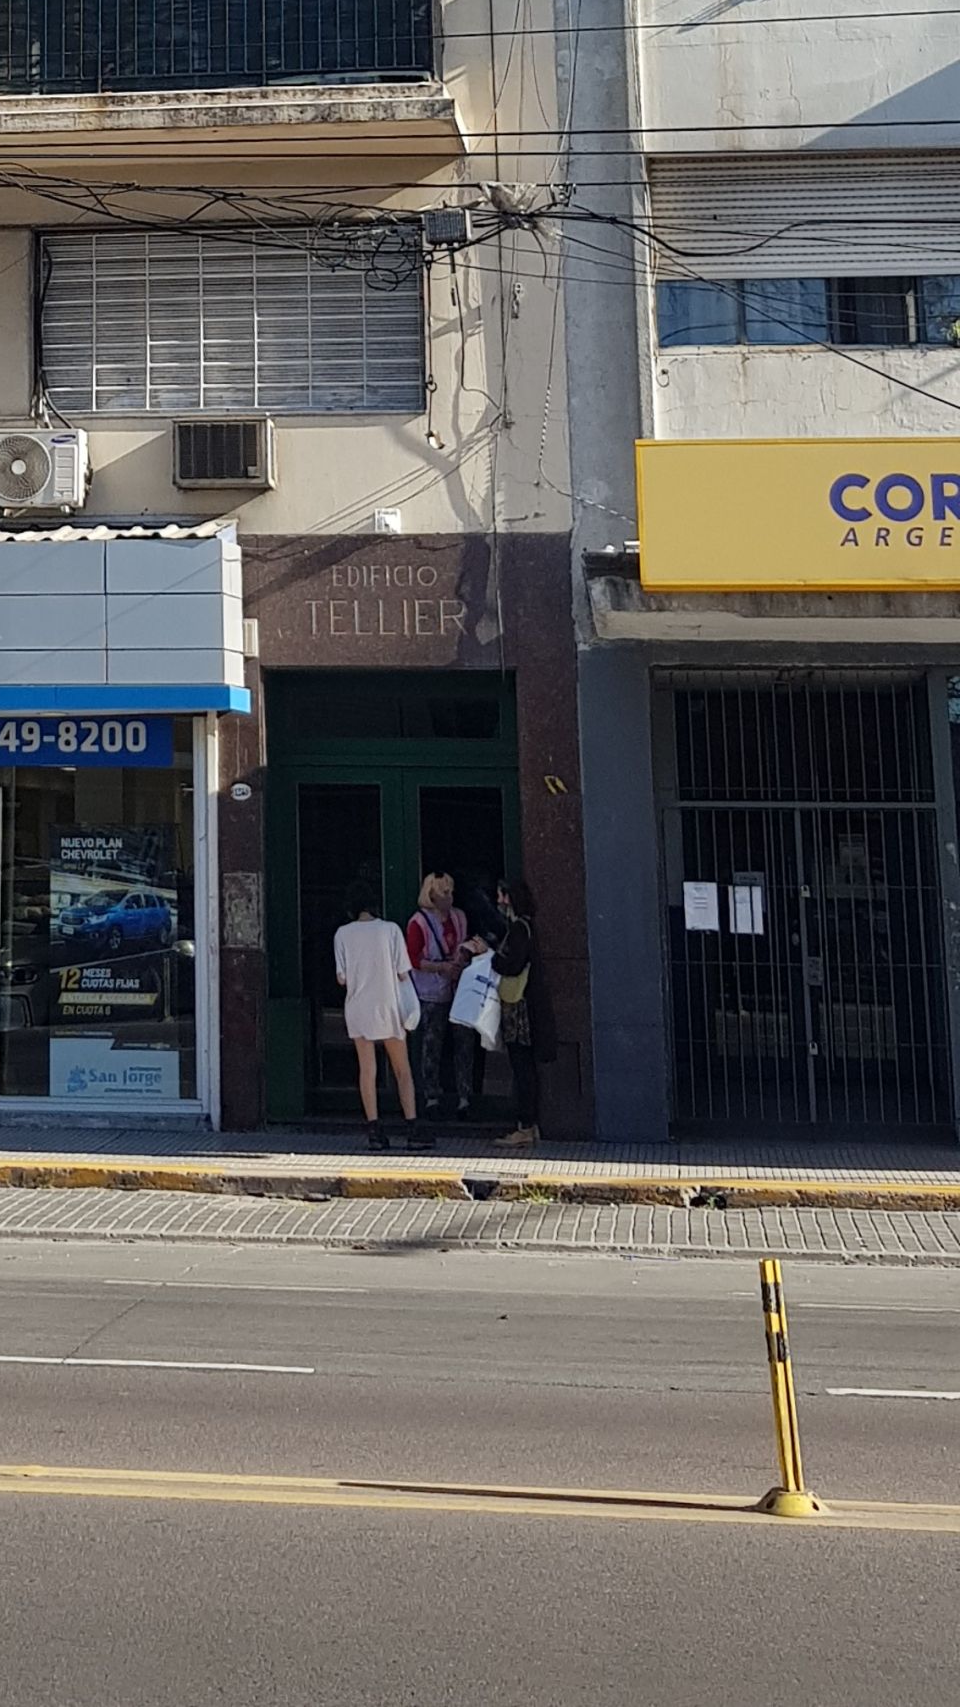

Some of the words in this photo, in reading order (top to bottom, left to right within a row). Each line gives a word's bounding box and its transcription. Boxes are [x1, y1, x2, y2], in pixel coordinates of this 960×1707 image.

[829, 472, 960, 522] COR
[840, 527, 954, 547] ARGE
[332, 565, 438, 587] EDIFICIO
[305, 598, 468, 636] TELLIER
[60, 837, 94, 848] NUEVO
[96, 837, 123, 849] PLAN
[60, 849, 118, 860] CHEVROLET
[59, 967, 81, 990] 12
[81, 978, 115, 989] CUOTAS
[88, 1068, 118, 1083] San
[122, 1069, 162, 1086] Jorge
